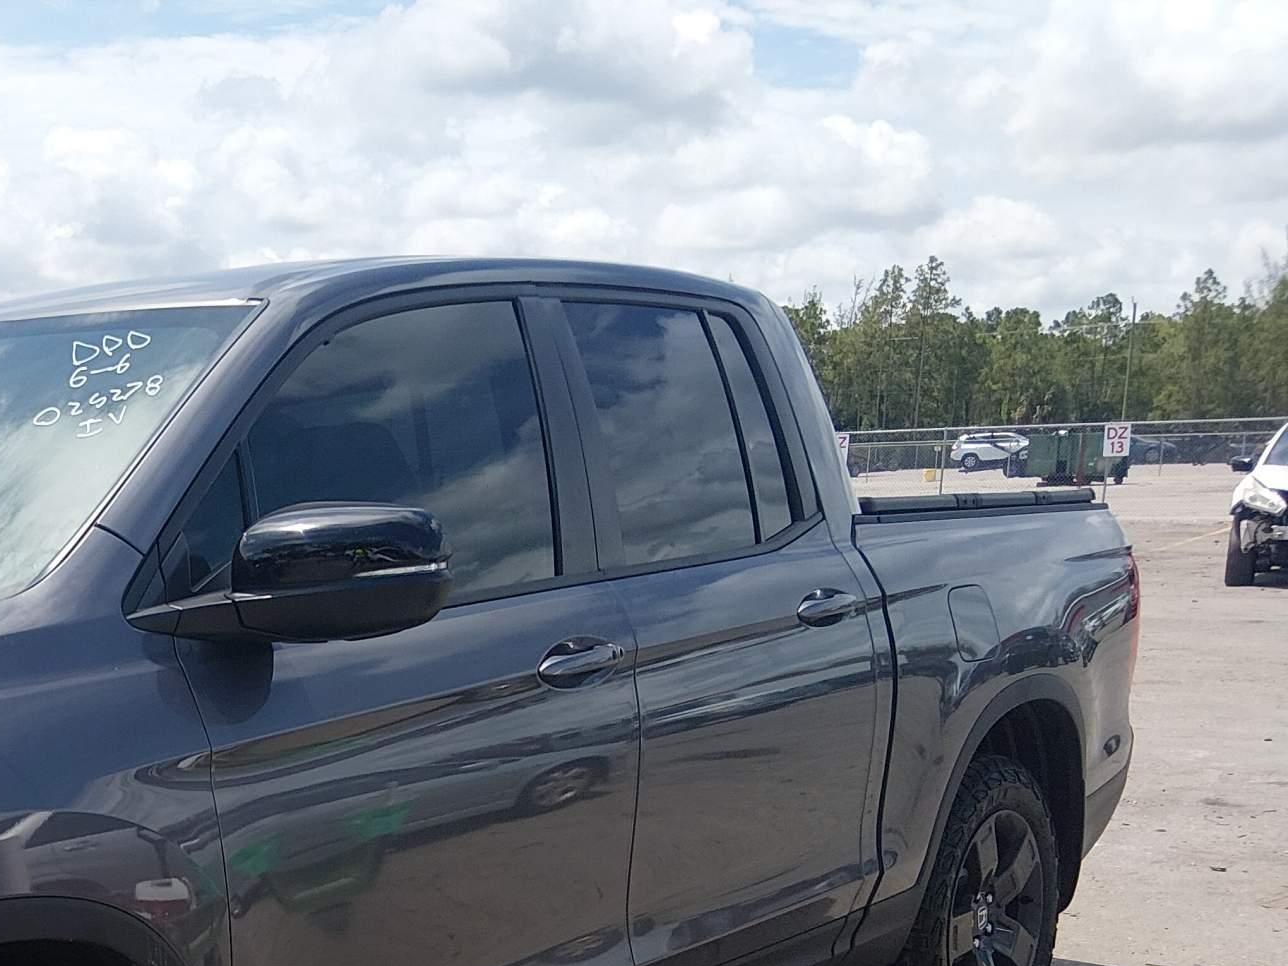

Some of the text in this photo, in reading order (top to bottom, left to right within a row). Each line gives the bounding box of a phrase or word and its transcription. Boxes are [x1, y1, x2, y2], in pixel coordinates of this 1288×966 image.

[69, 353, 131, 388] 6-6
[1106, 426, 1128, 440] DZ
[1110, 441, 1124, 454] 13
